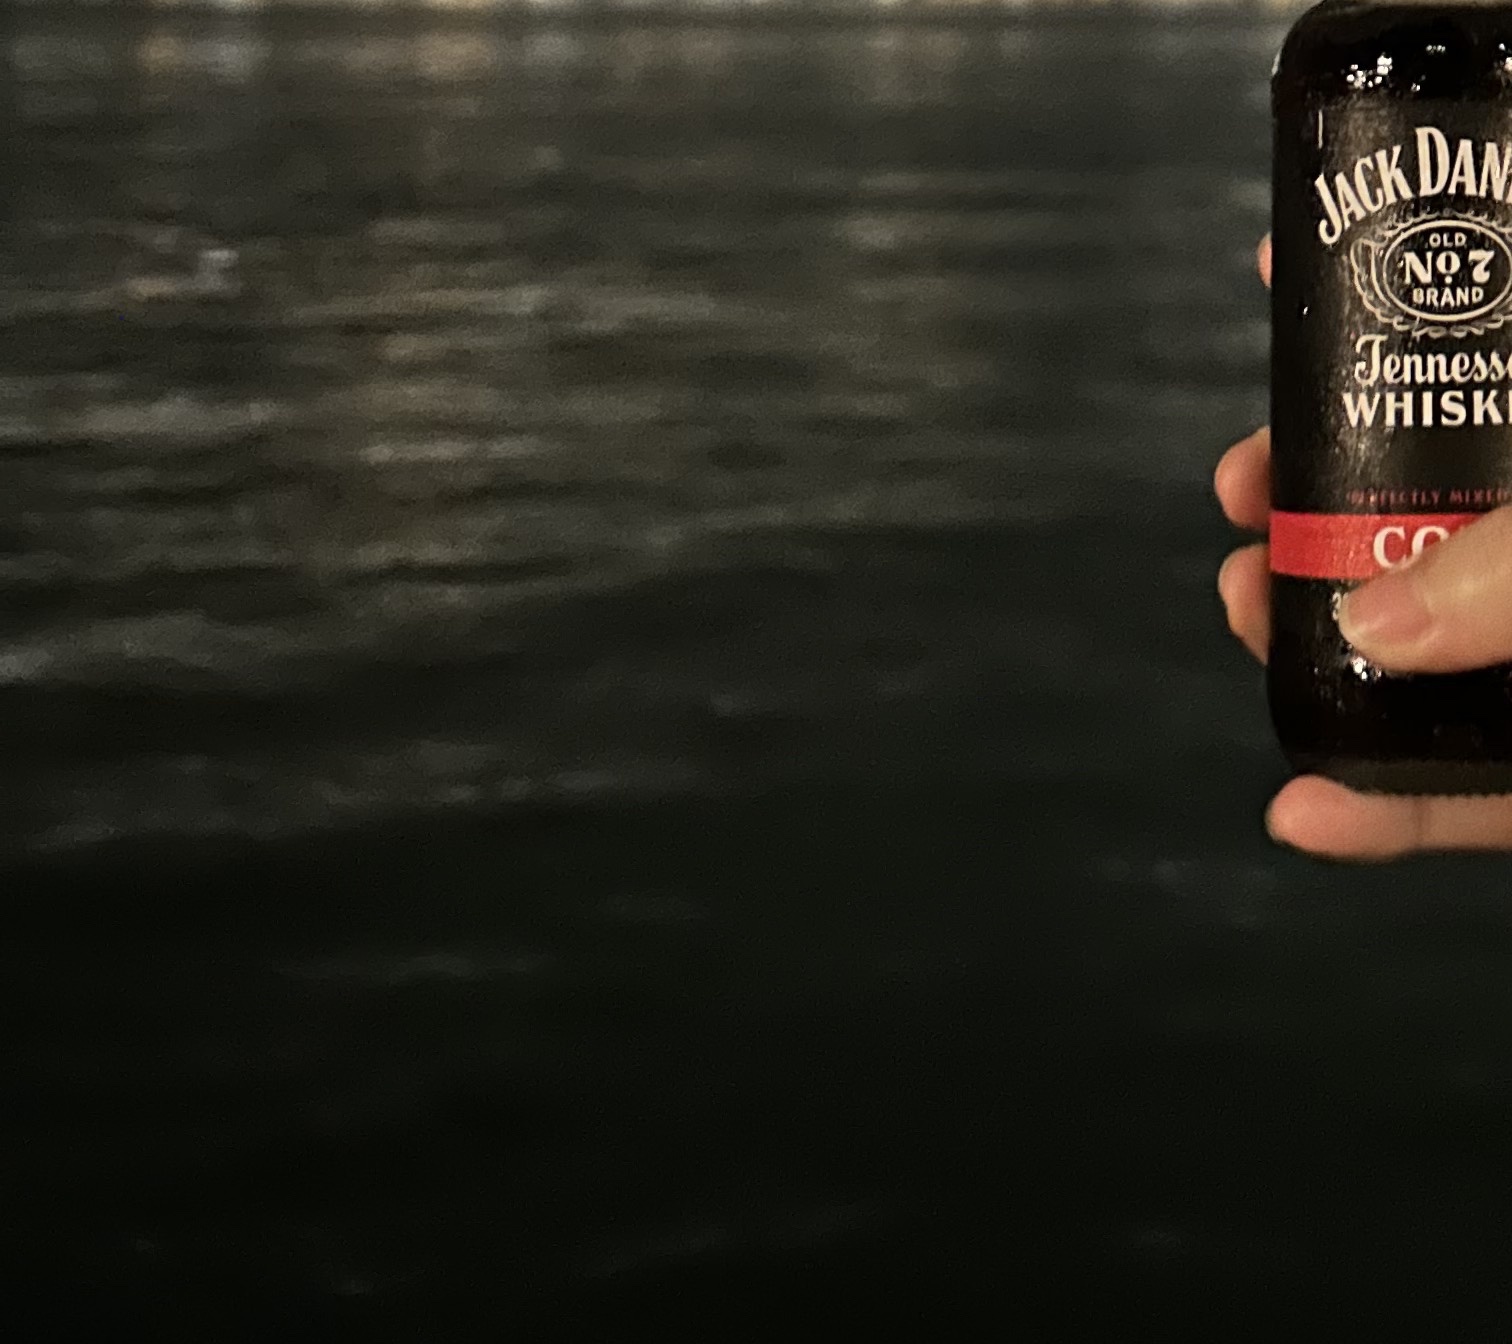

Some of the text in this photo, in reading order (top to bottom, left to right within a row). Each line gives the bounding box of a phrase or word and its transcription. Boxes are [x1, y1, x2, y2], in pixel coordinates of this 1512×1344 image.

[1314, 144, 1414, 245] JACK
[1428, 233, 1467, 248] OLD
[1412, 286, 1484, 308] BRAND
